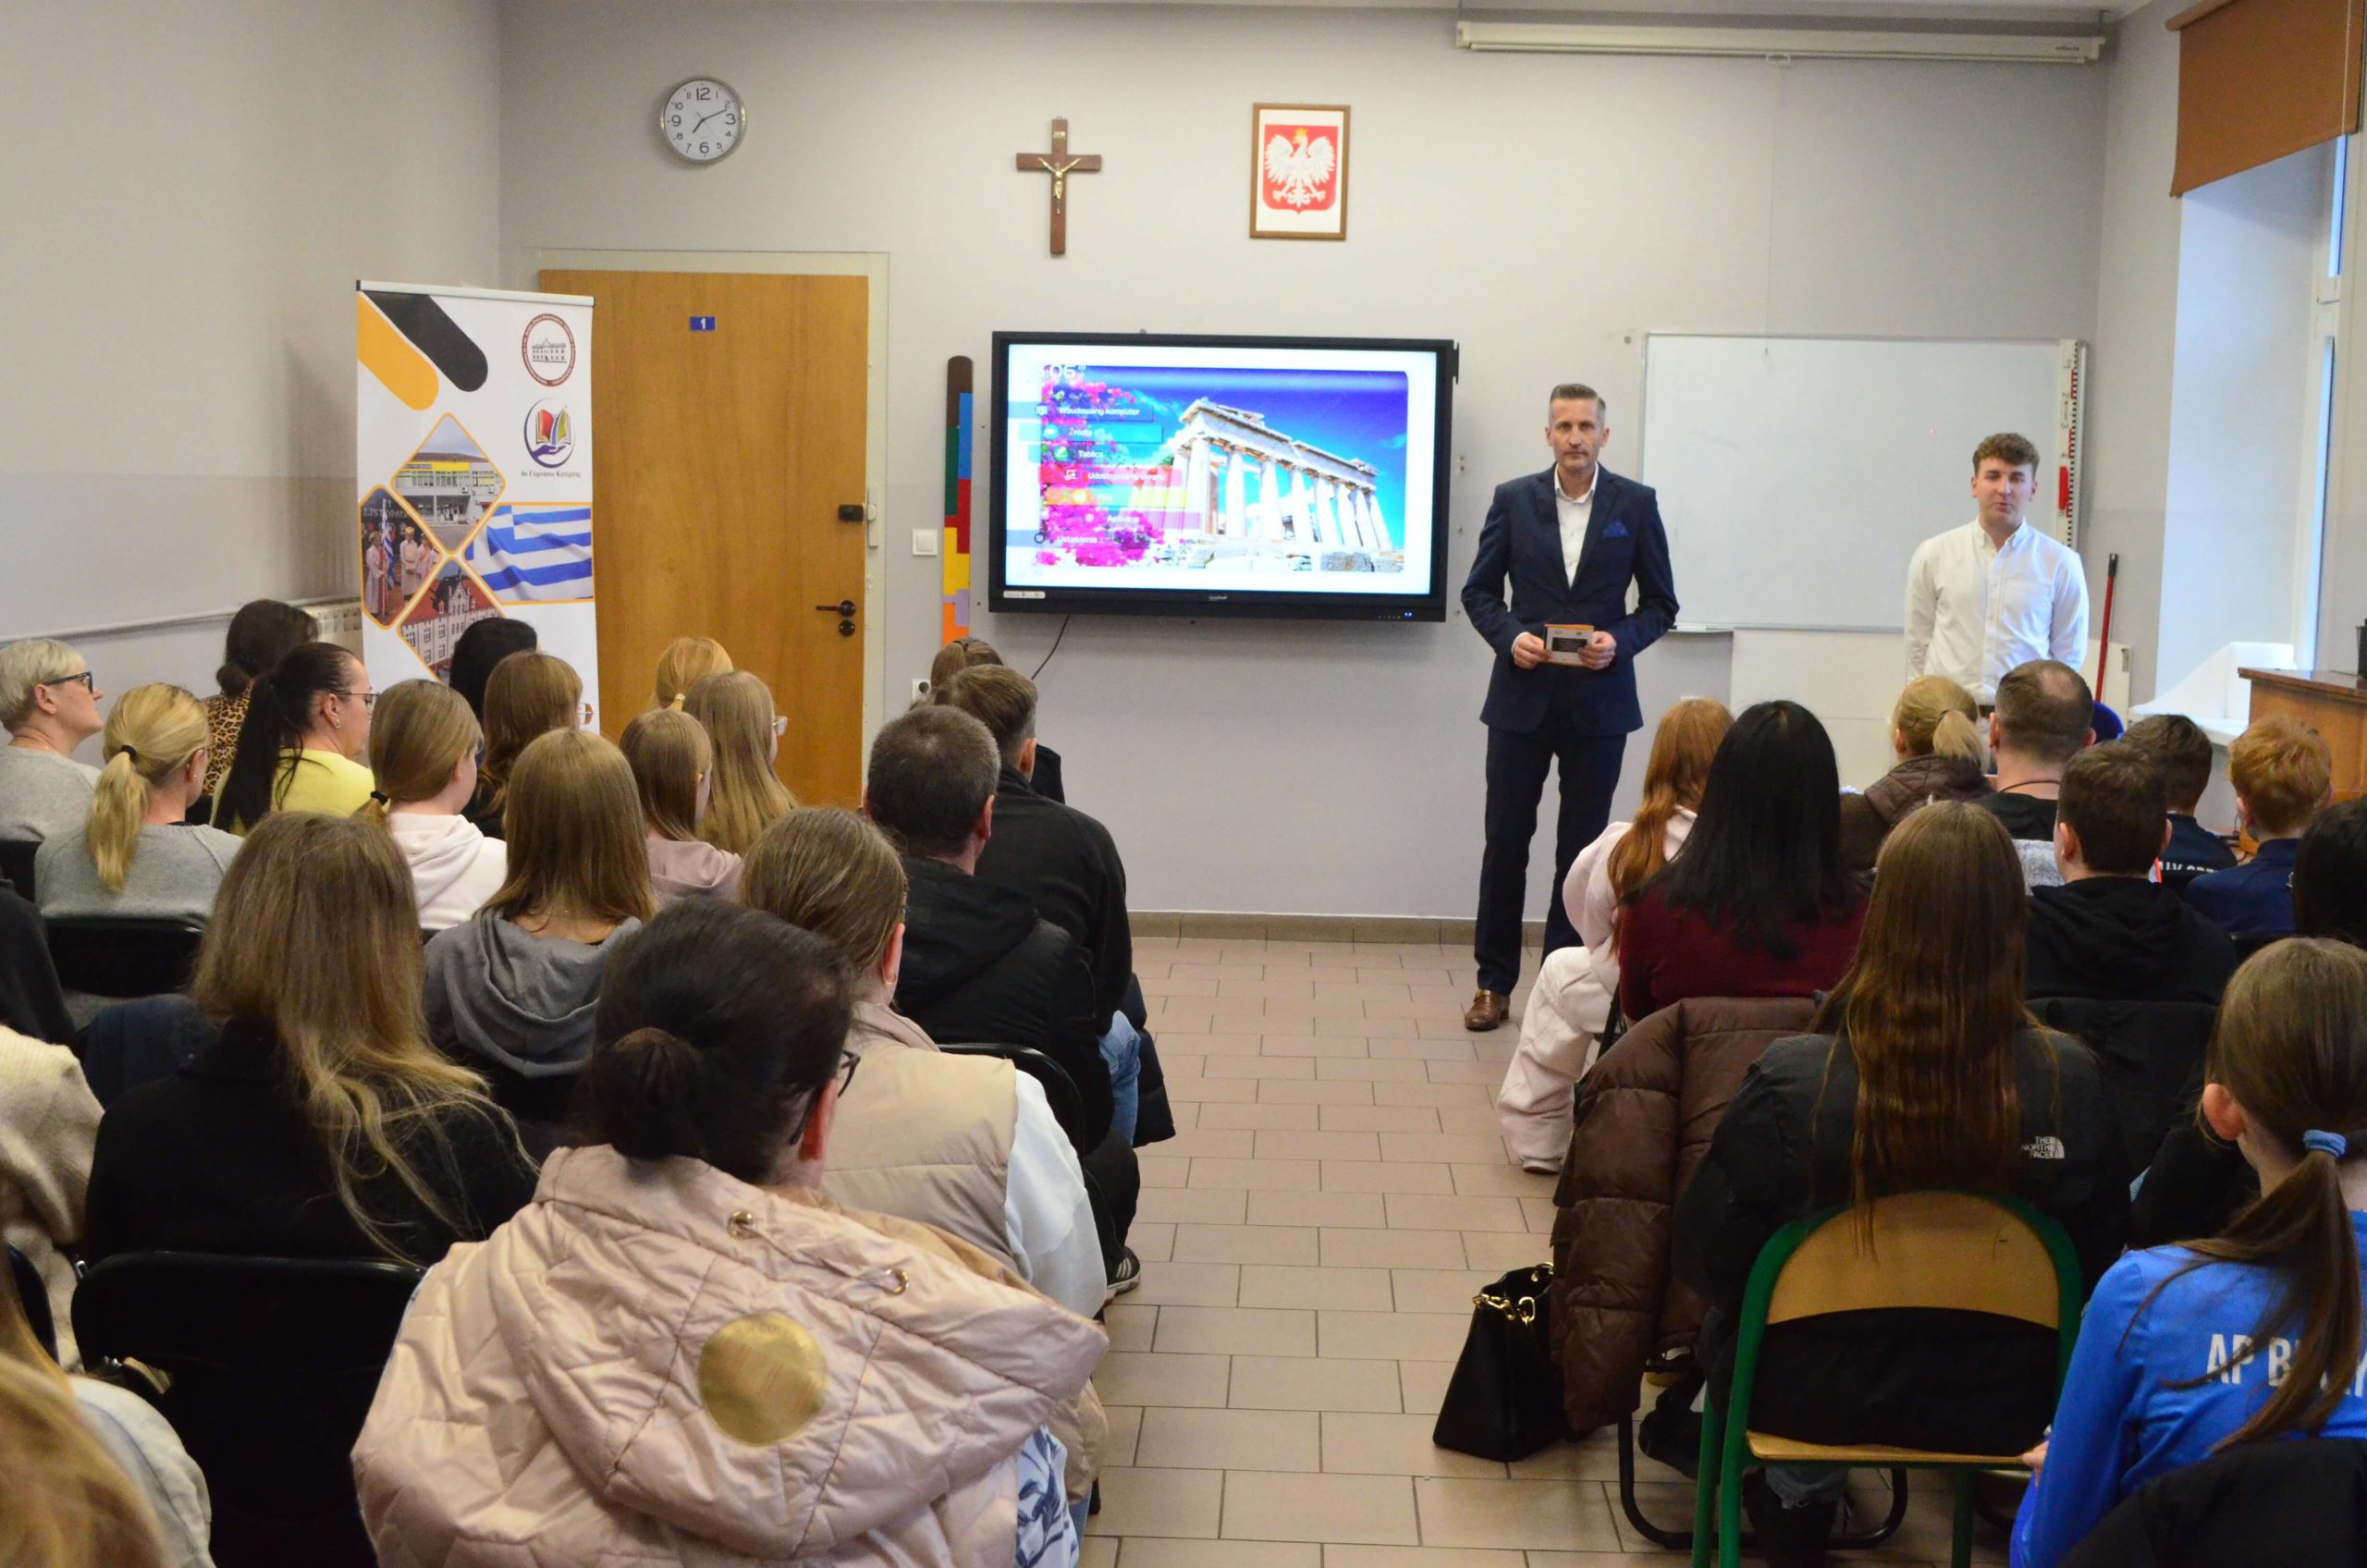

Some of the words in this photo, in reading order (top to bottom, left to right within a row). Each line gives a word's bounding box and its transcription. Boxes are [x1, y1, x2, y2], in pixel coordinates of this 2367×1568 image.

[686, 92, 692, 100] 11
[696, 87, 711, 101] 12
[674, 102, 683, 110] 10
[670, 115, 681, 127] 9
[725, 113, 736, 126] 3
[686, 142, 692, 153] 7
[699, 141, 709, 154] 6
[700, 317, 706, 330] 1
[1059, 406, 1104, 416] Wbudowany
[1105, 406, 1140, 416] komputer
[1078, 449, 1104, 459] Tablica
[2034, 1136, 2050, 1145] THE
[2030, 1151, 2050, 1159] FACE
[2206, 1333, 2254, 1385] AP
